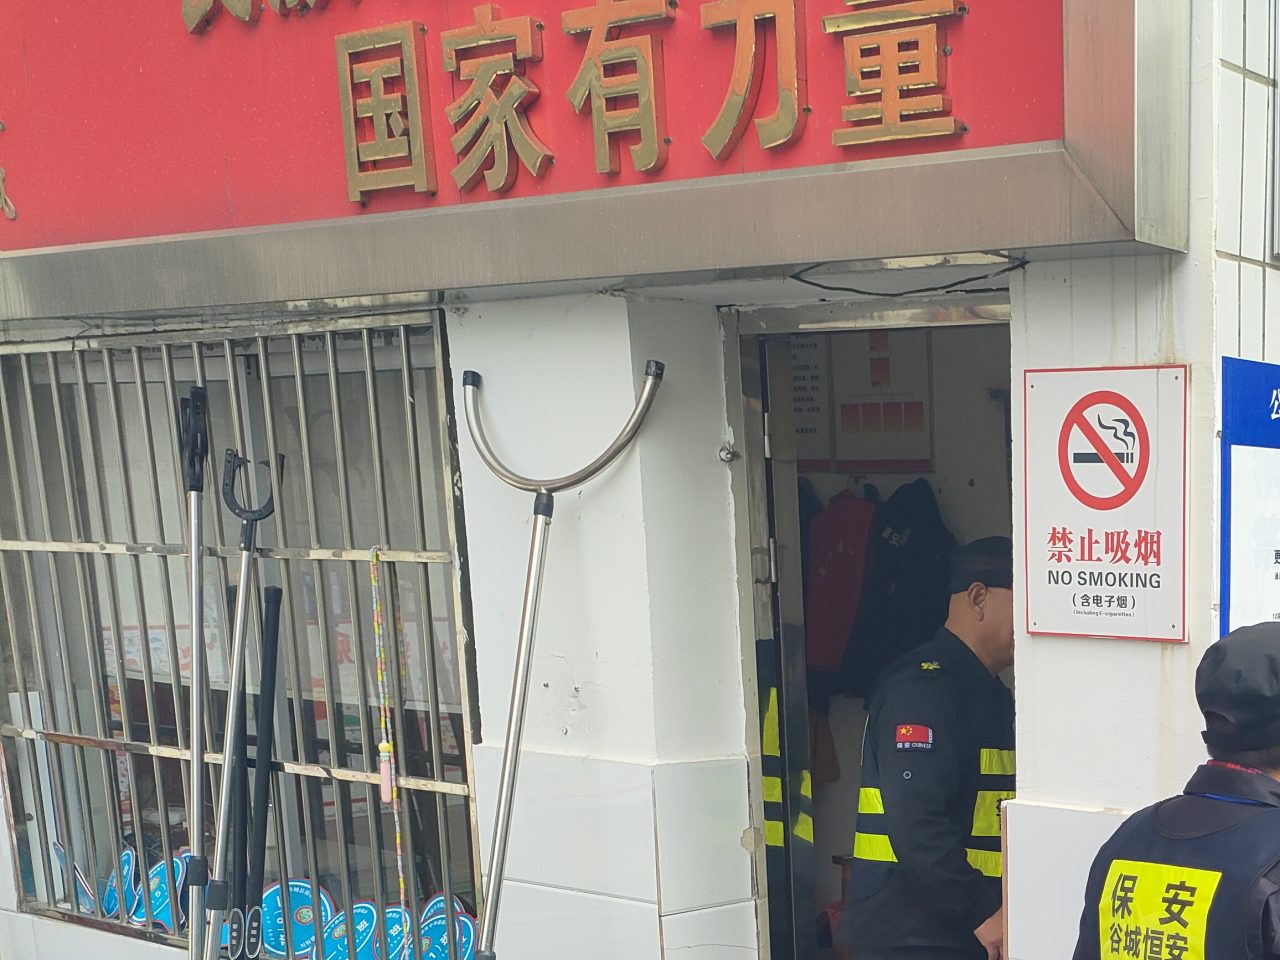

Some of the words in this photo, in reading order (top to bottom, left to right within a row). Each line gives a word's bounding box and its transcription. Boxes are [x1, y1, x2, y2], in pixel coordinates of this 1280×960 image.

[334, 0, 957, 203] 国家有力量
[1047, 526, 1162, 567] 禁止吸烟
[1048, 569, 1073, 585] NO
[1077, 571, 1161, 589] SMOKING
[1072, 593, 1136, 610] （含电子烟）
[1111, 873, 1197, 929] 保安
